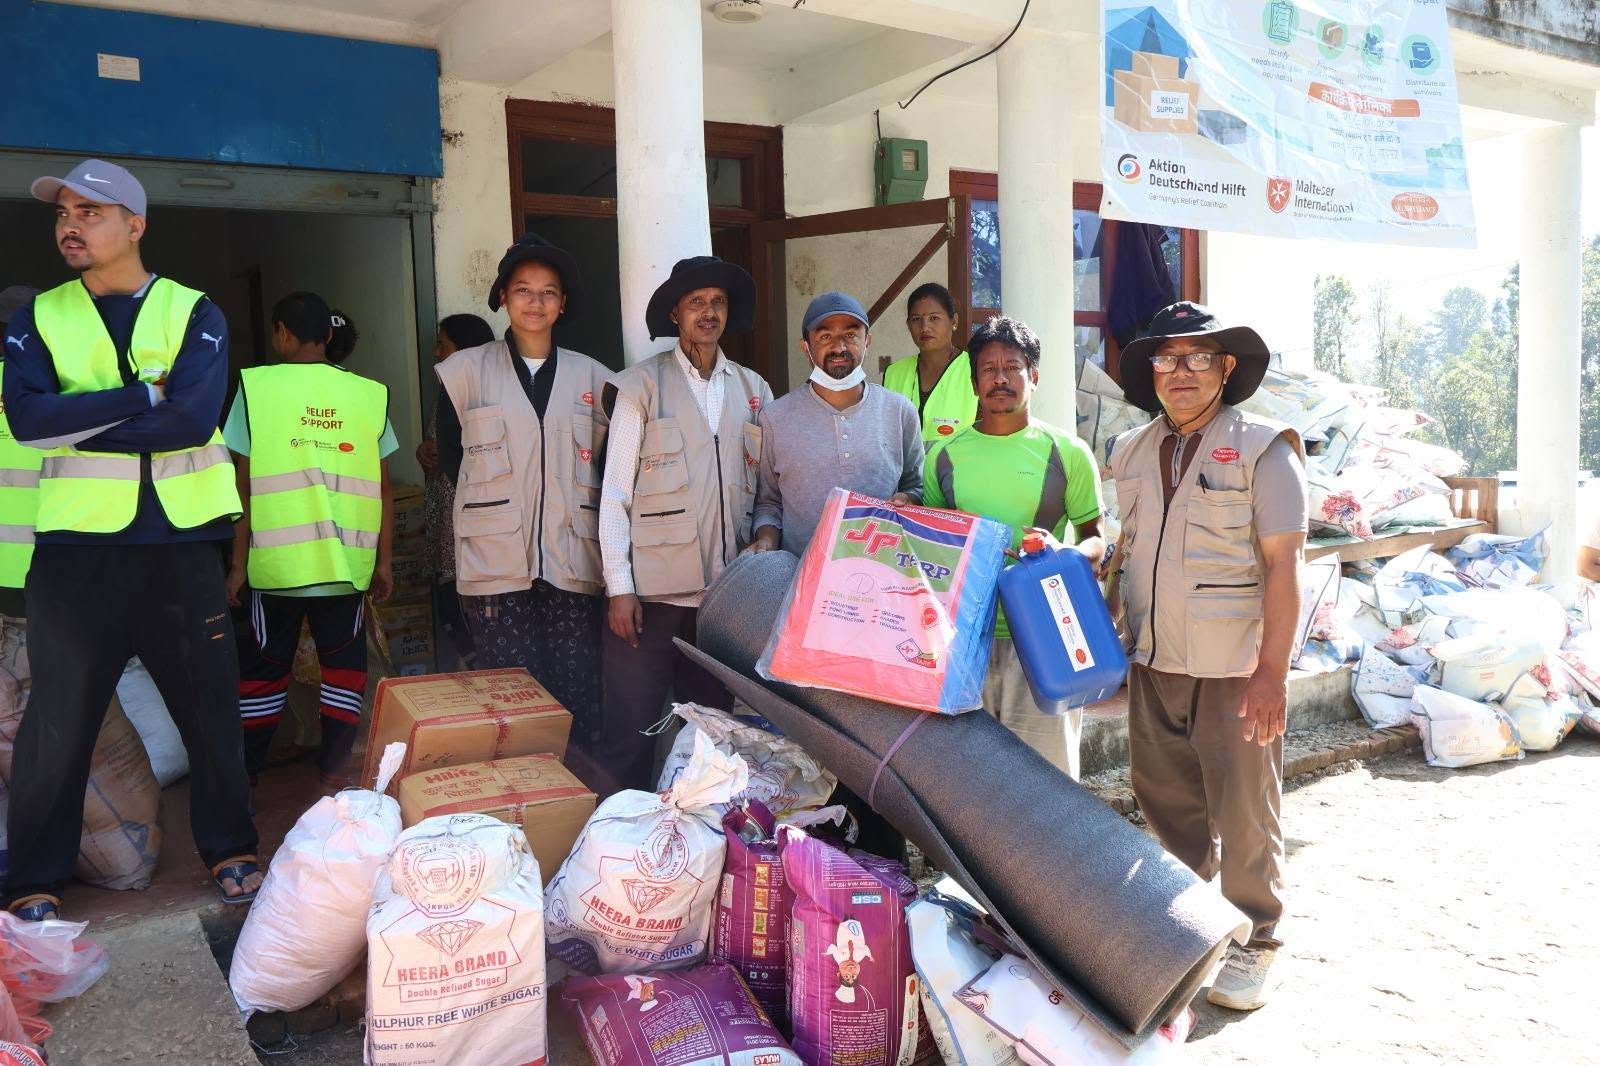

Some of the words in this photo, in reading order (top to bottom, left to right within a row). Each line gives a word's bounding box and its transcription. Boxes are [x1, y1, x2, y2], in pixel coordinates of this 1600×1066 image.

[1149, 158, 1186, 174] Aktion
[1149, 173, 1218, 194] Deutschland
[1221, 183, 1247, 197] Hilft
[1295, 179, 1335, 197] Malteser
[1294, 195, 1355, 214] International
[306, 406, 336, 417] RELIEF
[843, 520, 902, 556] JP
[895, 552, 951, 580] TARP
[852, 895, 881, 904] CSR
[590, 895, 631, 927] HEERA
[635, 916, 683, 931] BRAND
[590, 915, 614, 935] Double
[615, 929, 647, 941] Refined
[649, 934, 671, 944] Sugar
[624, 947, 660, 962] WHITE
[659, 944, 694, 962] SUGAR
[398, 963, 449, 982] HEERA
[454, 950, 508, 974] BRAND
[407, 985, 438, 998] Double
[440, 980, 473, 993] Refined
[475, 974, 501, 988] Sugar
[427, 1010, 459, 1026] FREE
[461, 1000, 498, 1019] WHITE
[500, 986, 541, 1005] SUGAR
[373, 1042, 398, 1051] EIGHT
[754, 1054, 781, 1066] HULAS
